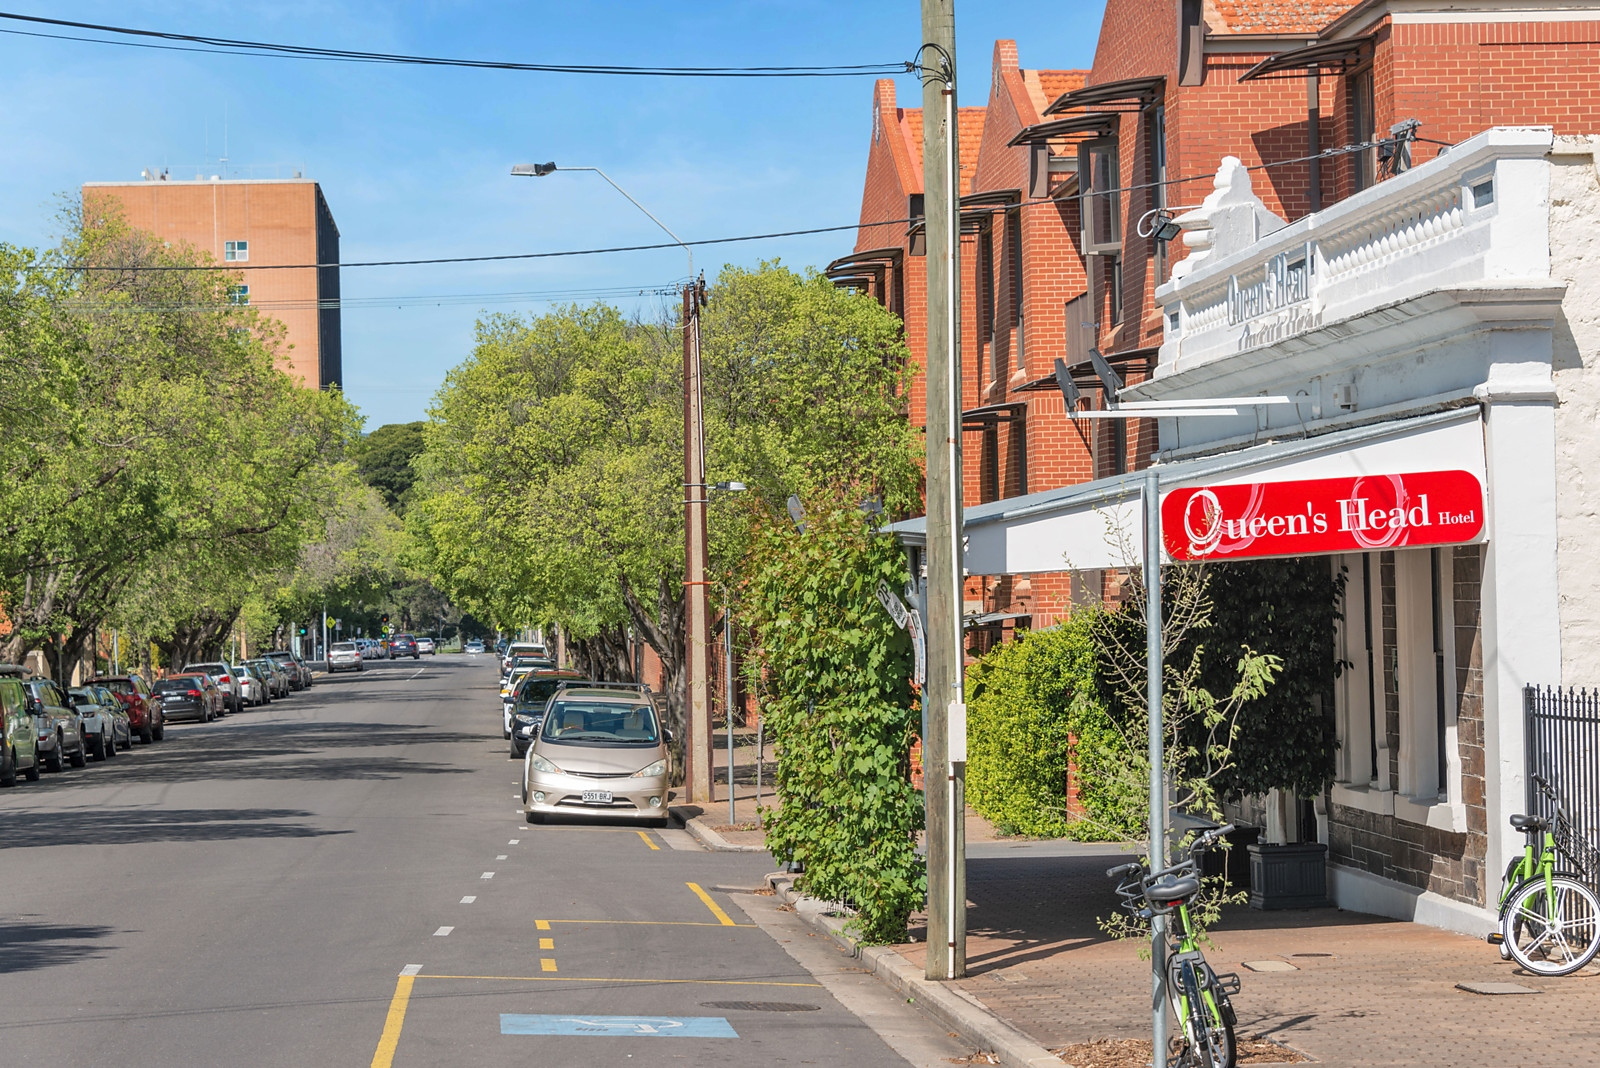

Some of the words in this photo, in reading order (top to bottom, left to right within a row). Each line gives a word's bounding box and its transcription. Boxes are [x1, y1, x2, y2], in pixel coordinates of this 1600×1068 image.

[1275, 241, 1310, 308] Head
[1184, 490, 1328, 556] Queen's
[1336, 494, 1432, 532] Head
[1438, 510, 1475, 525] Hotel
[878, 583, 891, 606] 2P
